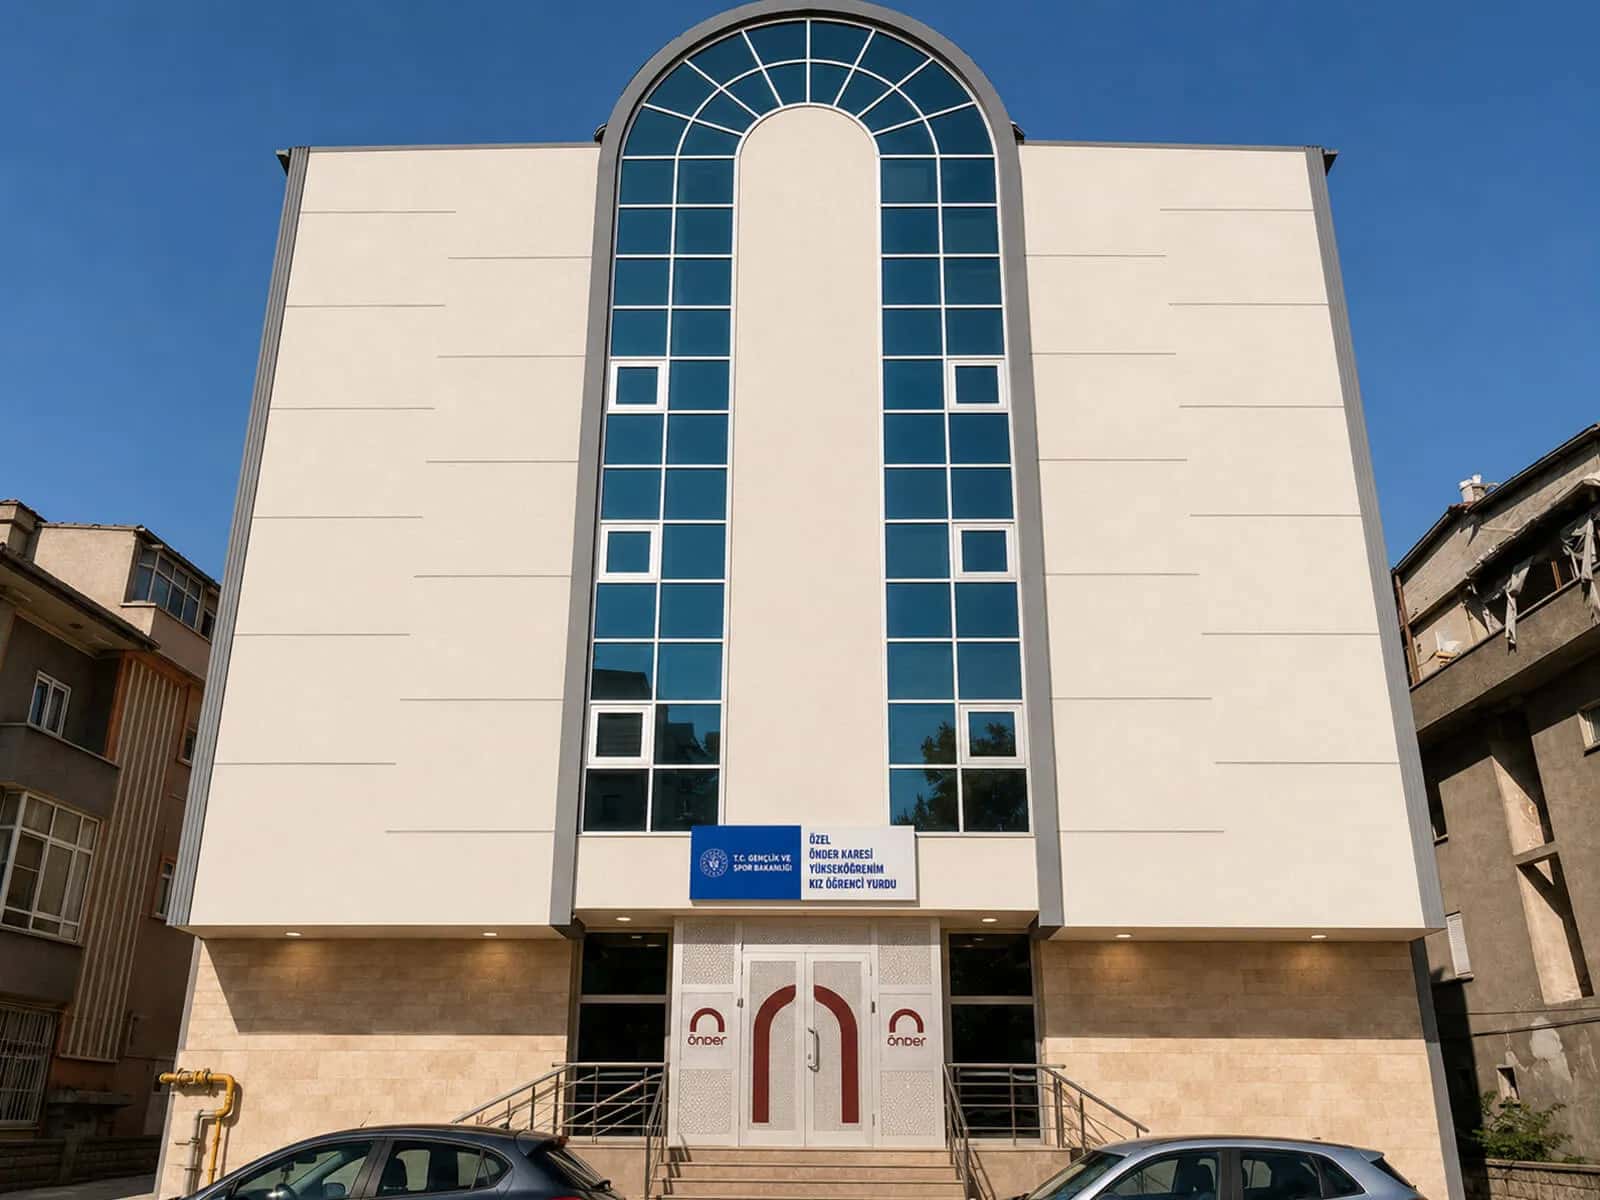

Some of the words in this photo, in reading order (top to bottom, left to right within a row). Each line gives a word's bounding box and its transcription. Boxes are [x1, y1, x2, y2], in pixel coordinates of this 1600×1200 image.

[809, 833, 831, 845] ÖZEL
[747, 853, 780, 863] GENÇLİK
[781, 854, 792, 863] VE
[809, 848, 838, 860] ÖNDER
[841, 848, 873, 860] KARESİ
[733, 864, 753, 872] SPOR
[753, 864, 793, 873] BAKANLIĞI
[809, 862, 884, 874] YÜKSEKÖĞRENİM
[809, 878, 824, 889] KIZ
[826, 877, 865, 889] ÖĞRENCİ
[867, 879, 897, 889] YURDU
